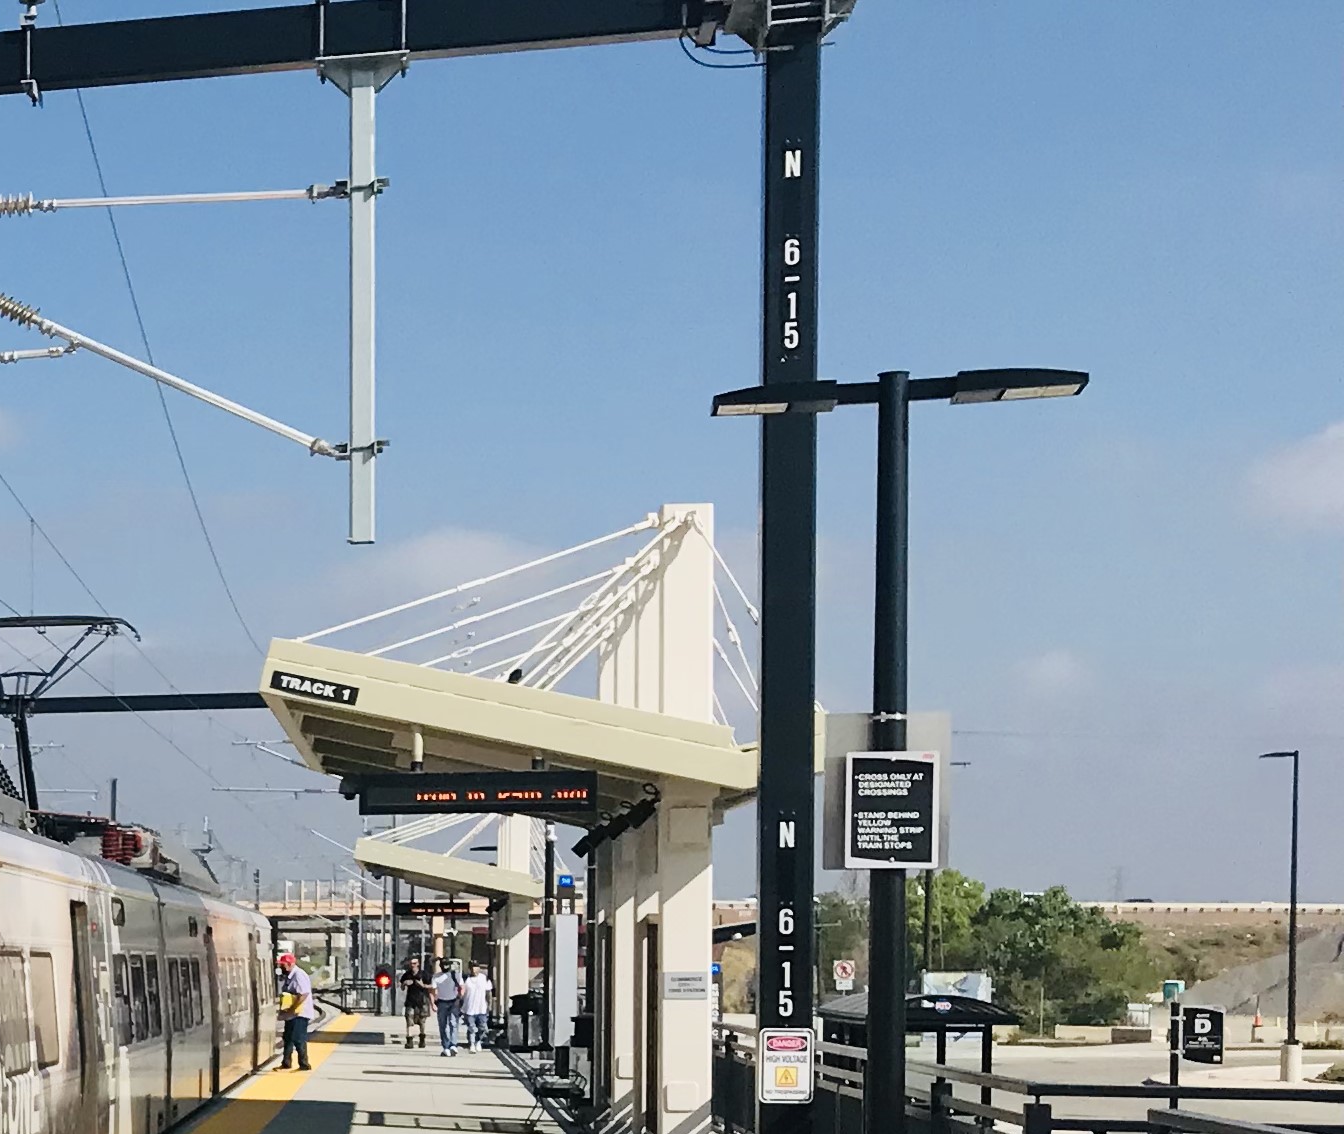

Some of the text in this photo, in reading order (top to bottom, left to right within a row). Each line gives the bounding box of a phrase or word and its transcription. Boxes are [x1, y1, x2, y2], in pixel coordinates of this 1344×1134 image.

[784, 150, 801, 178] N
[784, 238, 801, 349] 6-15
[280, 674, 351, 701] TRACK 1
[858, 773, 888, 781] CROSS
[890, 773, 912, 781] ONLY
[858, 788, 909, 796] CROSSINGS
[779, 821, 795, 848] N
[778, 908, 794, 1017] 6-15
[1194, 1018, 1212, 1034] D
[766, 1055, 807, 1063] HIGH VOLTAGE
